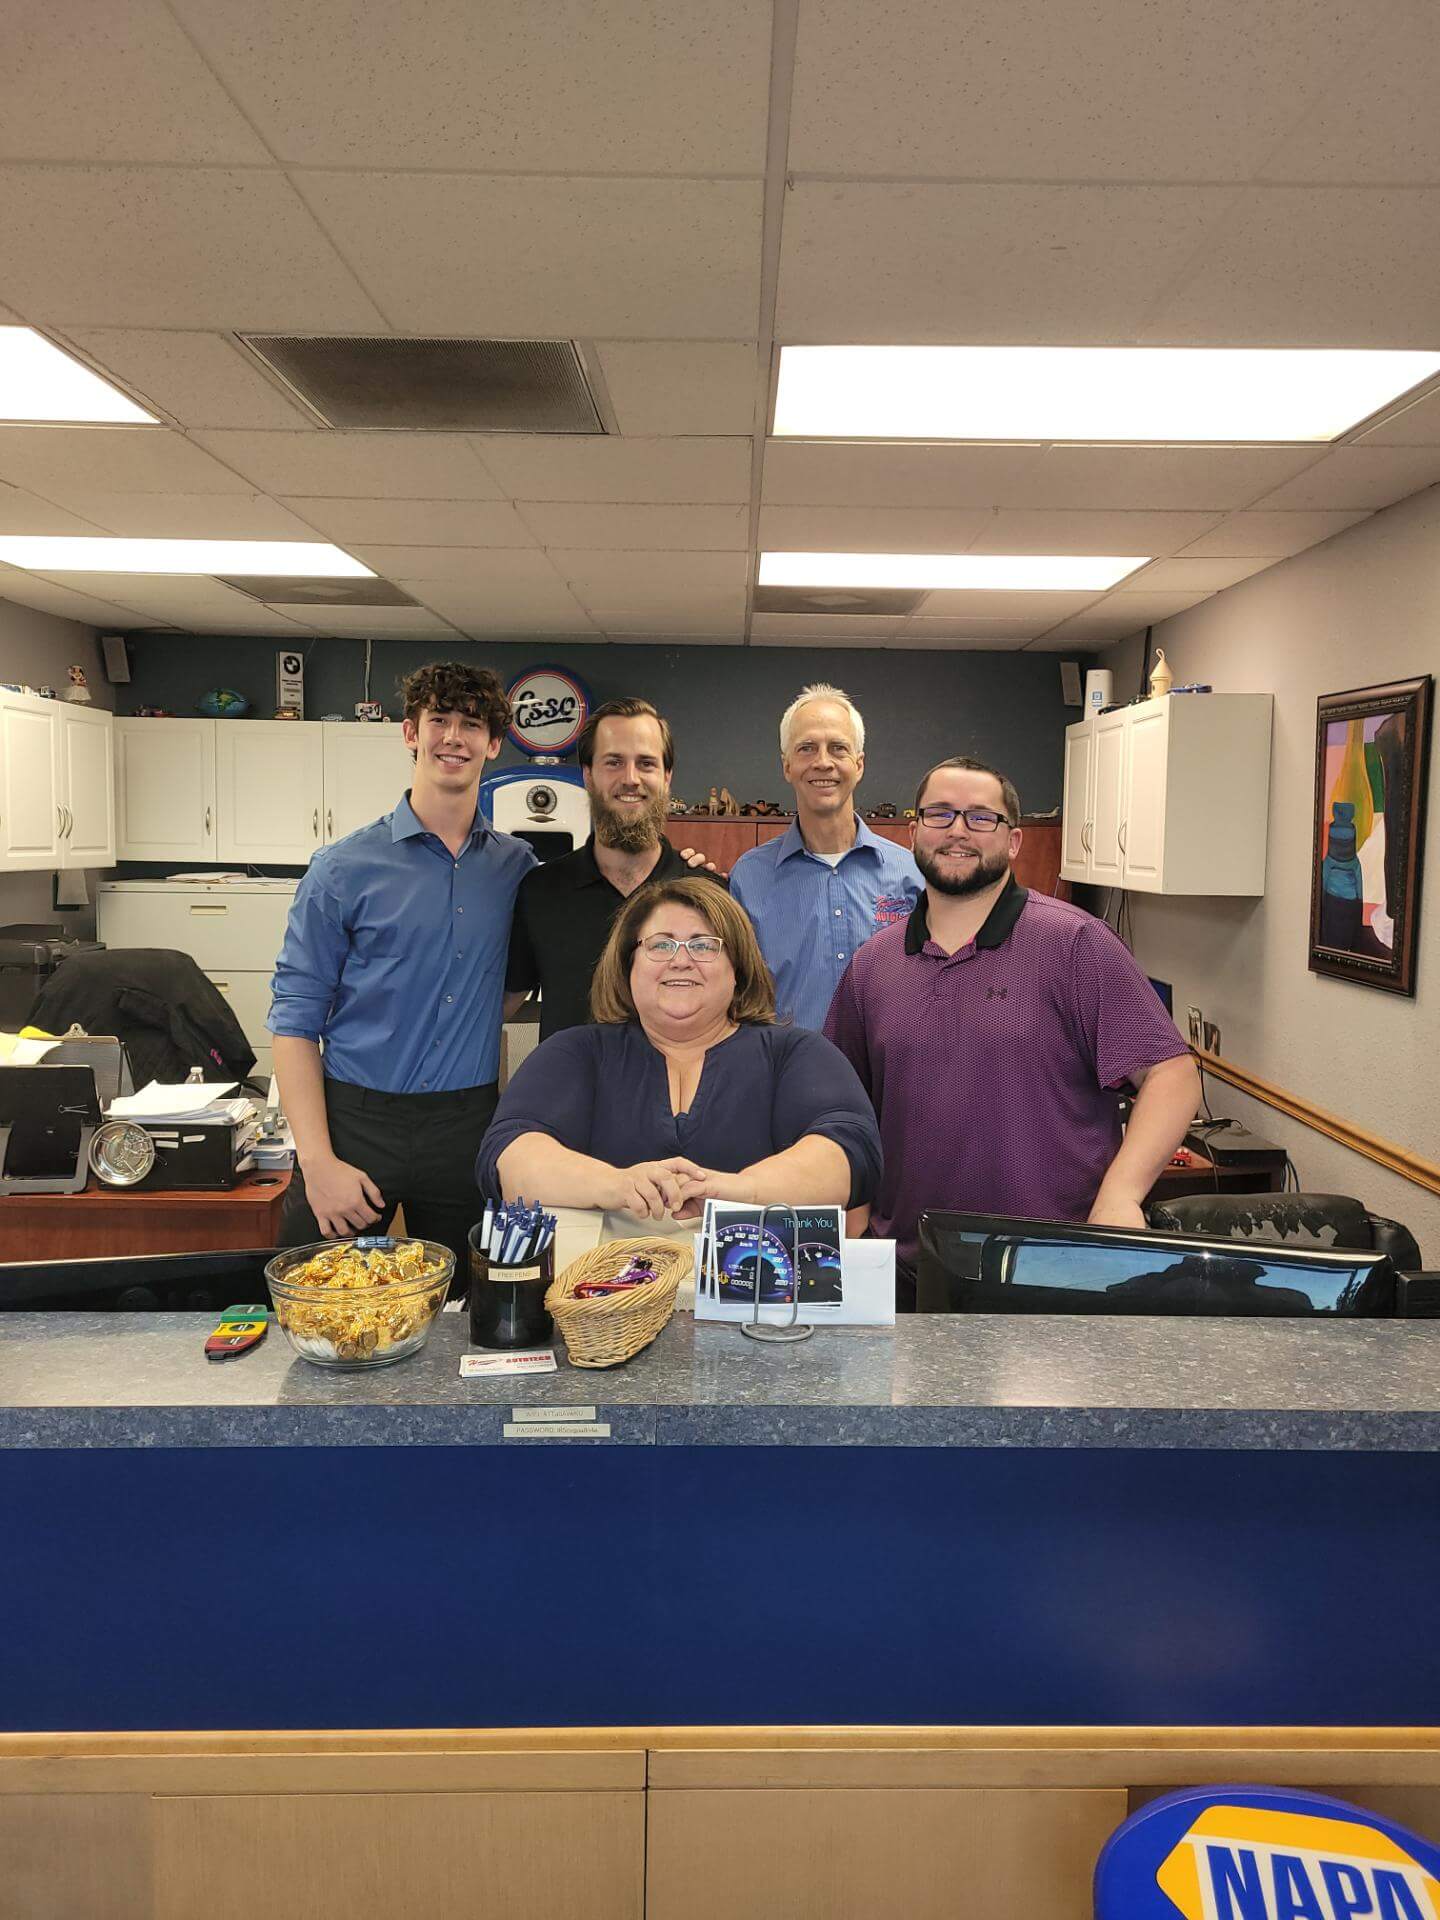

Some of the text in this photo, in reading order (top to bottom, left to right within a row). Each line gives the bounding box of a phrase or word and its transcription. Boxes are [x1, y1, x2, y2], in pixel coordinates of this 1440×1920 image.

[515, 690, 576, 729] Esso
[815, 1217, 833, 1228] You
[1206, 1845, 1426, 1920] NAPA
